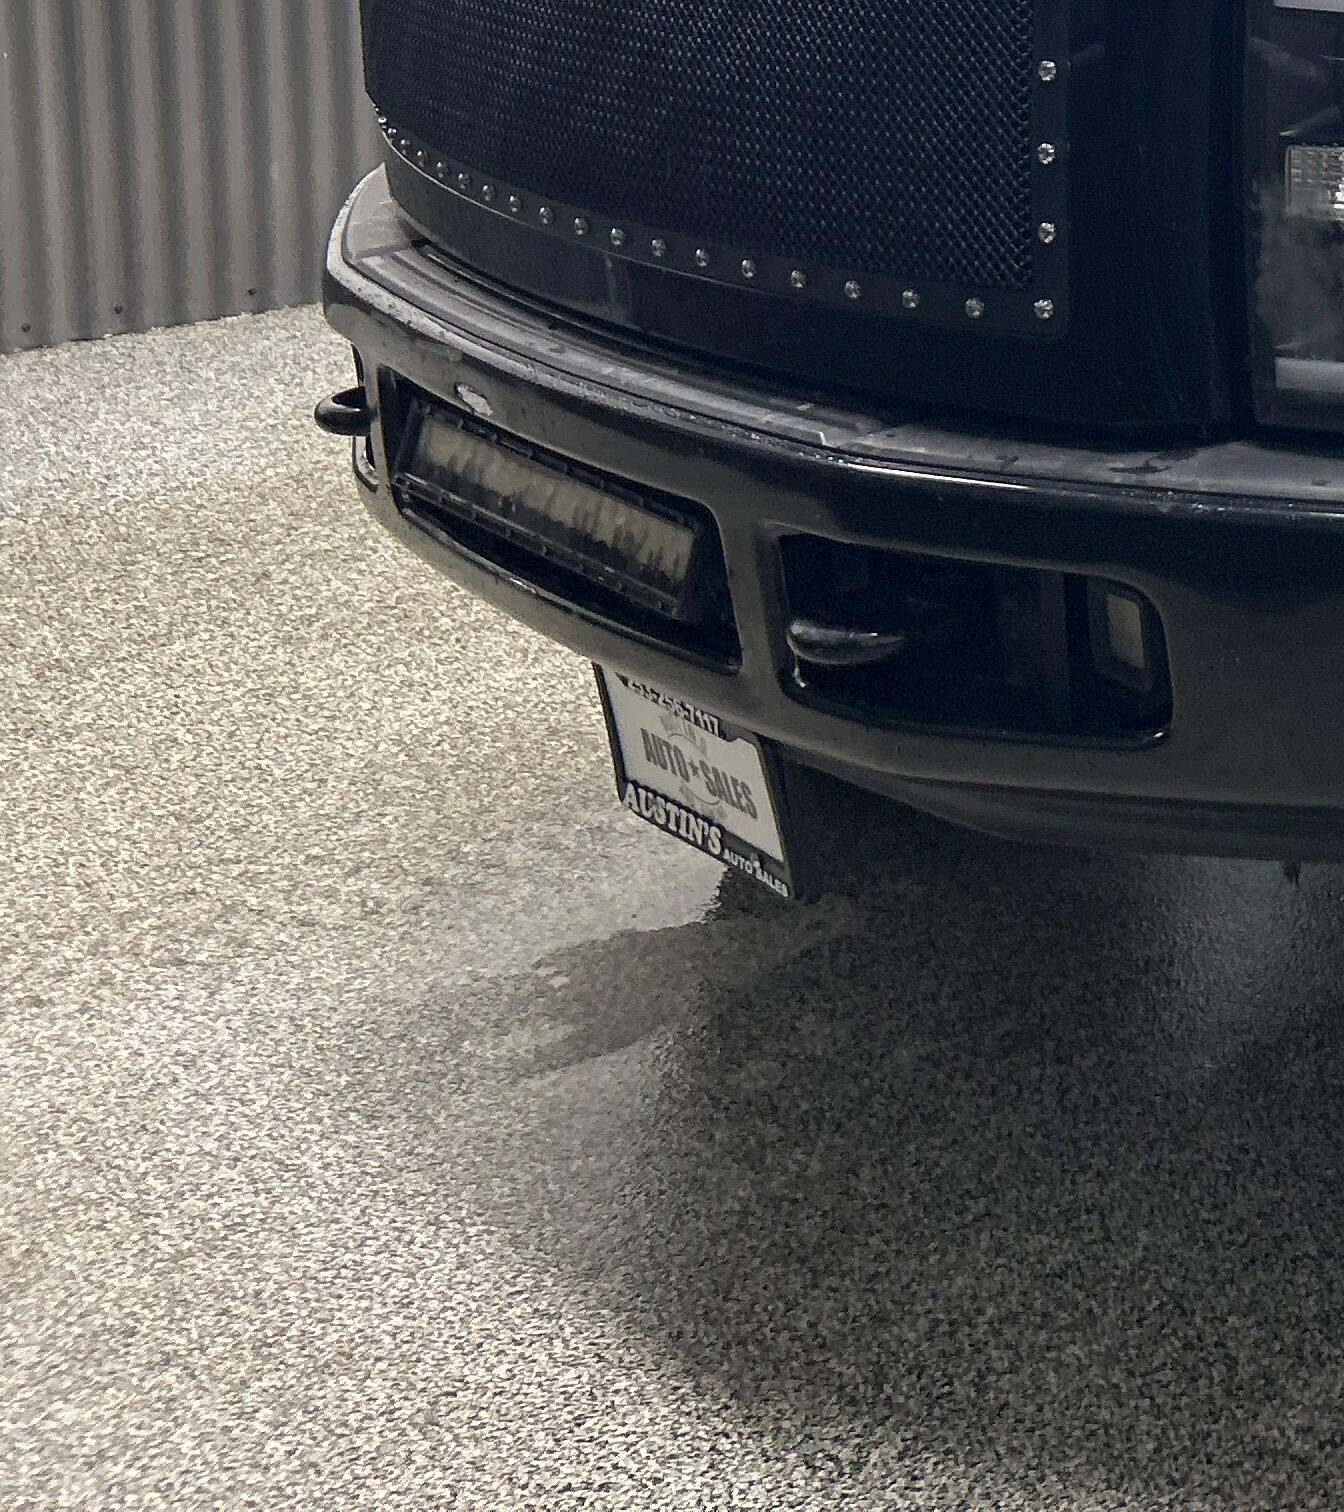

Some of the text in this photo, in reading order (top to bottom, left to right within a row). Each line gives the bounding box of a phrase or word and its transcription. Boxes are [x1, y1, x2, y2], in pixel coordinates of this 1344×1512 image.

[641, 727, 690, 783] AUTO
[699, 759, 758, 820] SALES
[623, 783, 723, 856] AUSTIN'S
